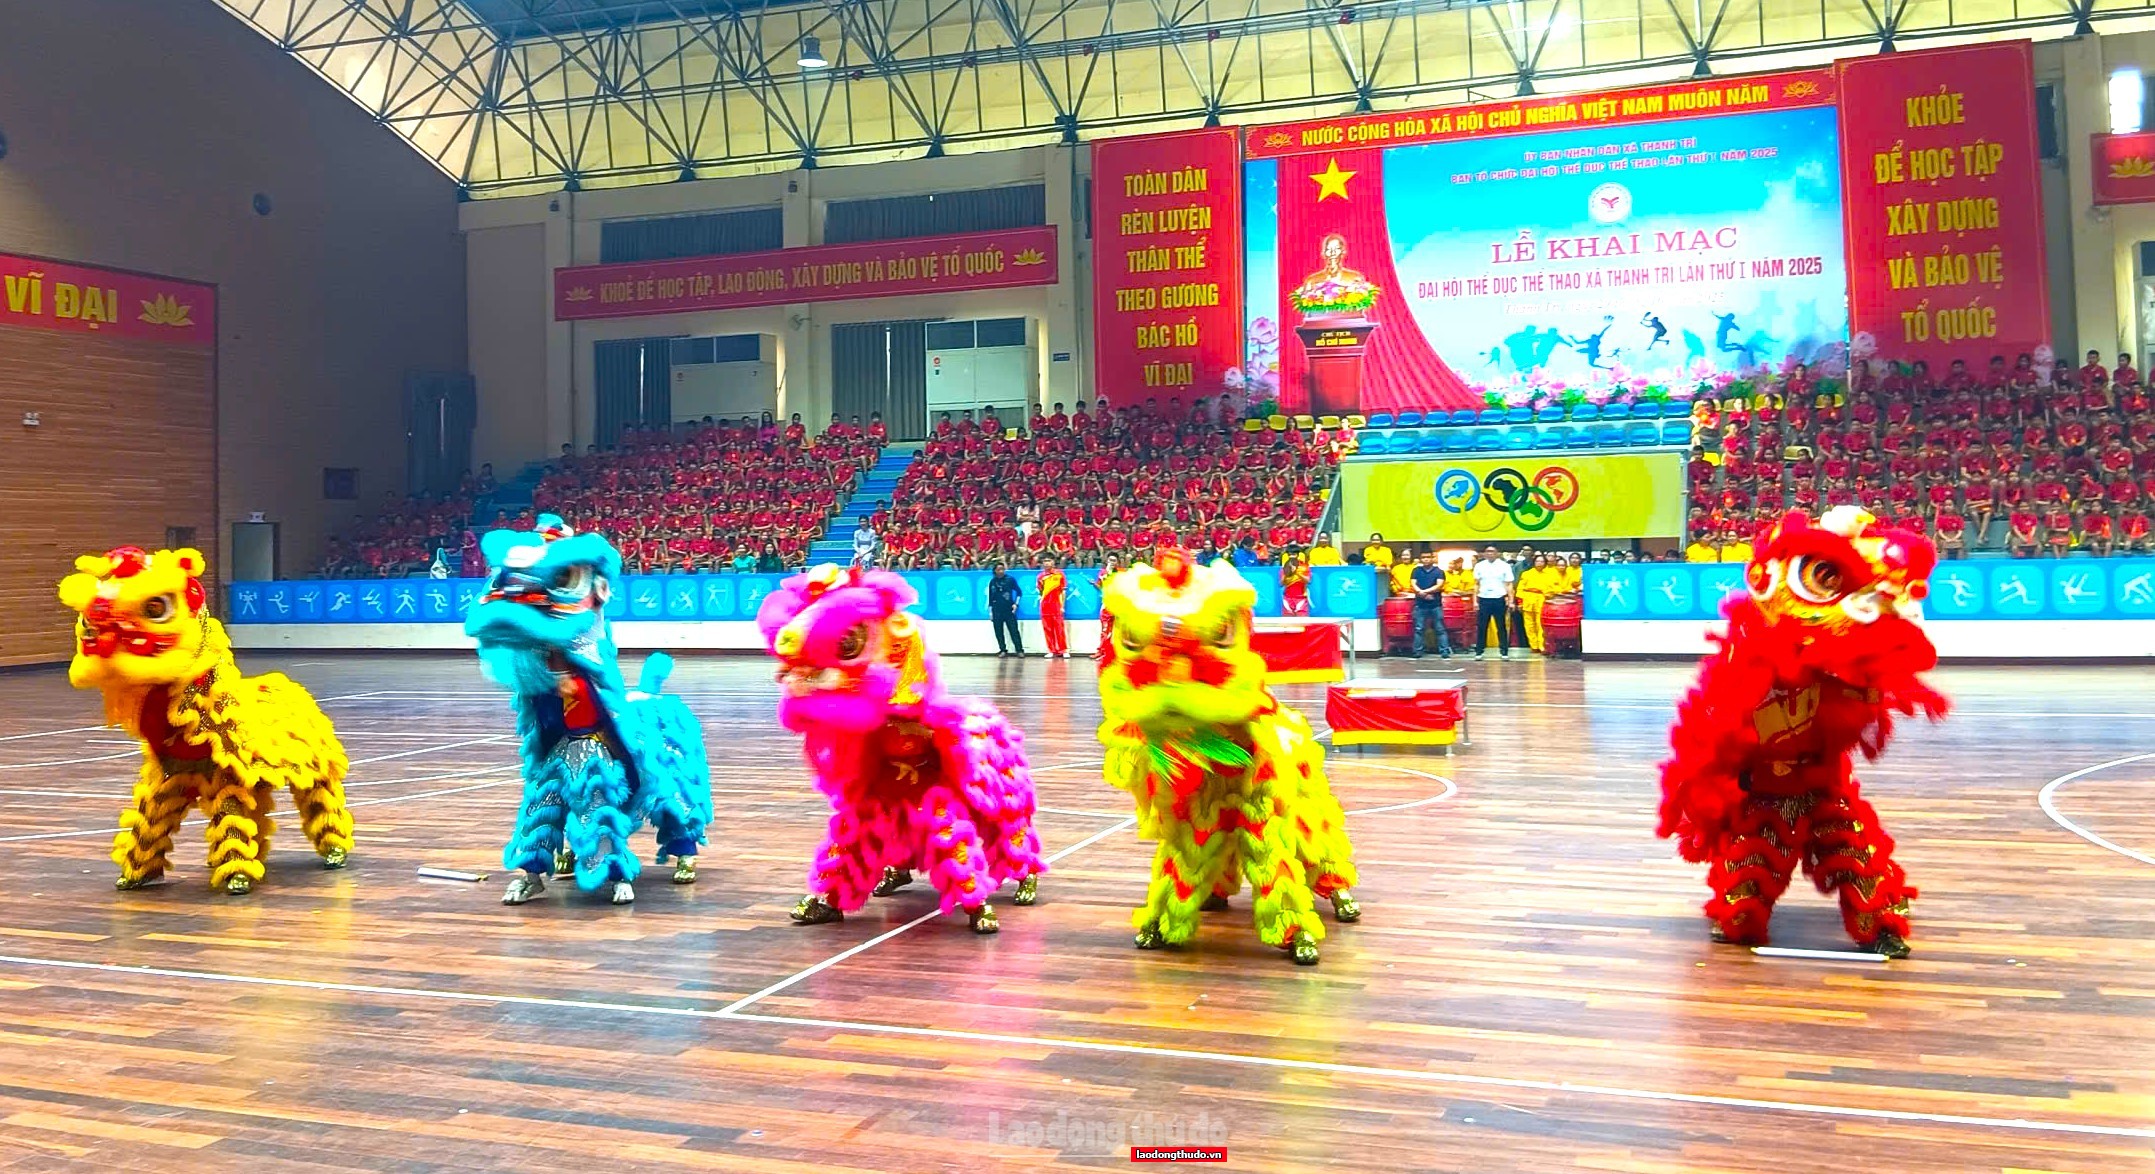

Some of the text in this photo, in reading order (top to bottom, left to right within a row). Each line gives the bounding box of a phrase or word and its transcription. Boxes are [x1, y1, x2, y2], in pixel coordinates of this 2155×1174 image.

[1302, 84, 1769, 146] NƯỚC CỘNG HÒA XÃ HỘI CHỦ NGHĨA VIỆT NAM MUÔN NĂM
[1906, 84, 1965, 128] KHỎE
[1452, 174, 1472, 184] BAN
[1751, 148, 1778, 158] 2025
[1540, 150, 1561, 160] BAN
[1642, 140, 1676, 150] THANH
[1874, 138, 2003, 186] ĐỂ HỌC TẬP
[1124, 166, 1206, 196] TOÀN DÂN
[1121, 204, 1211, 235] RÈN LUYỆN
[1887, 197, 1999, 238] XÂY DỰNG
[1127, 236, 1207, 272] THÂN THỂ
[1492, 228, 1737, 263] LỄ KHAI MẠC
[658, 277, 684, 302] HỌC
[718, 273, 742, 294] LAO
[747, 267, 788, 295] ĐỘNG,
[793, 262, 819, 288] XÂY
[823, 262, 861, 289] DỰNG
[865, 256, 884, 282] VÀ
[888, 252, 916, 280] BẢO
[921, 252, 939, 282] VỆ
[943, 246, 960, 276] TỔ
[965, 243, 1004, 276] QUỐC
[1549, 273, 1580, 290] THAO
[1607, 268, 1649, 286] THANH
[1740, 262, 1746, 278] I
[1789, 257, 1822, 276] 2025
[1888, 244, 2004, 289] VÀ BẢO VỆ
[4, 271, 118, 329] VĨ ĐẠI
[1116, 283, 1218, 312] THEO GƯƠNG
[1137, 316, 1198, 348] BÁC HỒ
[1902, 296, 1996, 342] TỔ QUỐC
[1144, 360, 1193, 390] VĨ ĐẠI
